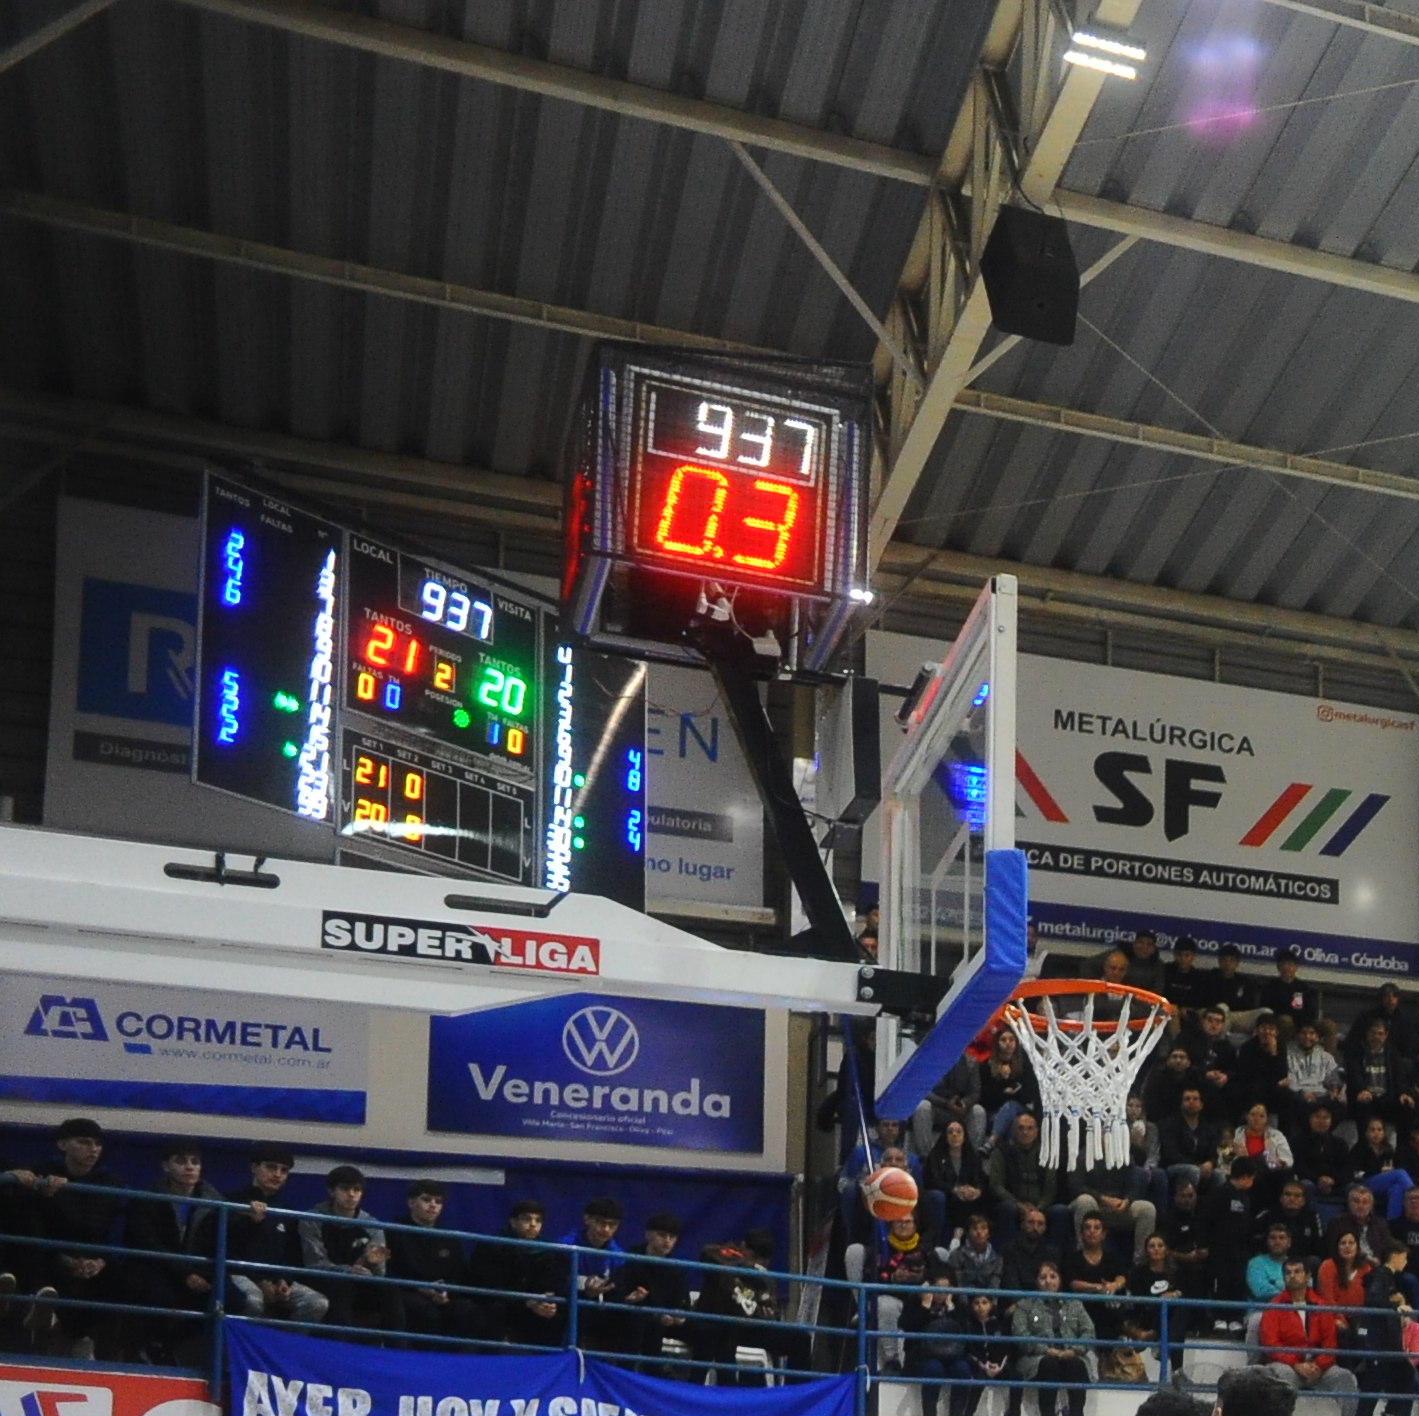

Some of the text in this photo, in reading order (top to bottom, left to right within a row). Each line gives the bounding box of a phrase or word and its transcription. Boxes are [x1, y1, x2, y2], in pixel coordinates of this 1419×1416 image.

[263, 499, 291, 517] LOCAL
[353, 538, 393, 564] LOCAL
[424, 567, 469, 594] TIEMPO
[363, 606, 413, 636] TANTOS
[499, 599, 533, 623] VISITA
[364, 621, 423, 676] 21
[433, 662, 455, 690] 2
[478, 651, 521, 678] TANTOS
[478, 665, 527, 717] 20
[361, 736, 378, 749] SET
[1053, 708, 1255, 757] METALÚRGICA
[396, 749, 413, 761] SET
[355, 756, 388, 789] 21
[1092, 751, 1228, 843] SF
[678, 858, 735, 882] lugar
[1060, 853, 1332, 900] DE PORTONES AUTOMÁTICOS
[1350, 952, 1410, 973] Córdoba
[116, 1011, 333, 1054] CORMETAL
[468, 1062, 732, 1119] Veneranda
